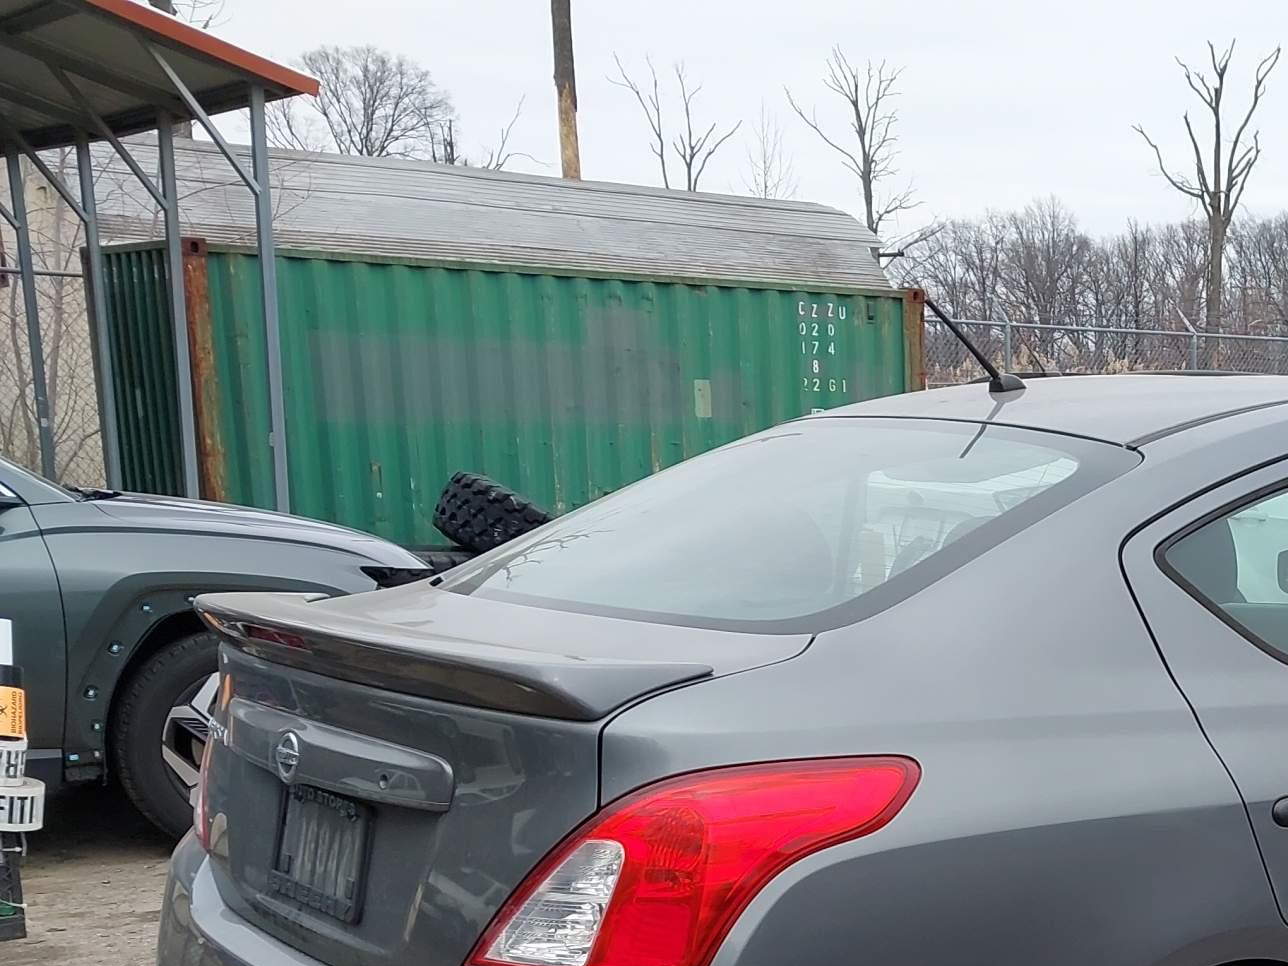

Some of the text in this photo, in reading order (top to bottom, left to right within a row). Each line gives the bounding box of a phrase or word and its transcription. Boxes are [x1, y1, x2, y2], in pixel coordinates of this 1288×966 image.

[798, 301, 846, 320] CZZU
[799, 322, 835, 337] 020
[801, 341, 835, 356] 174
[812, 359, 819, 374] 8
